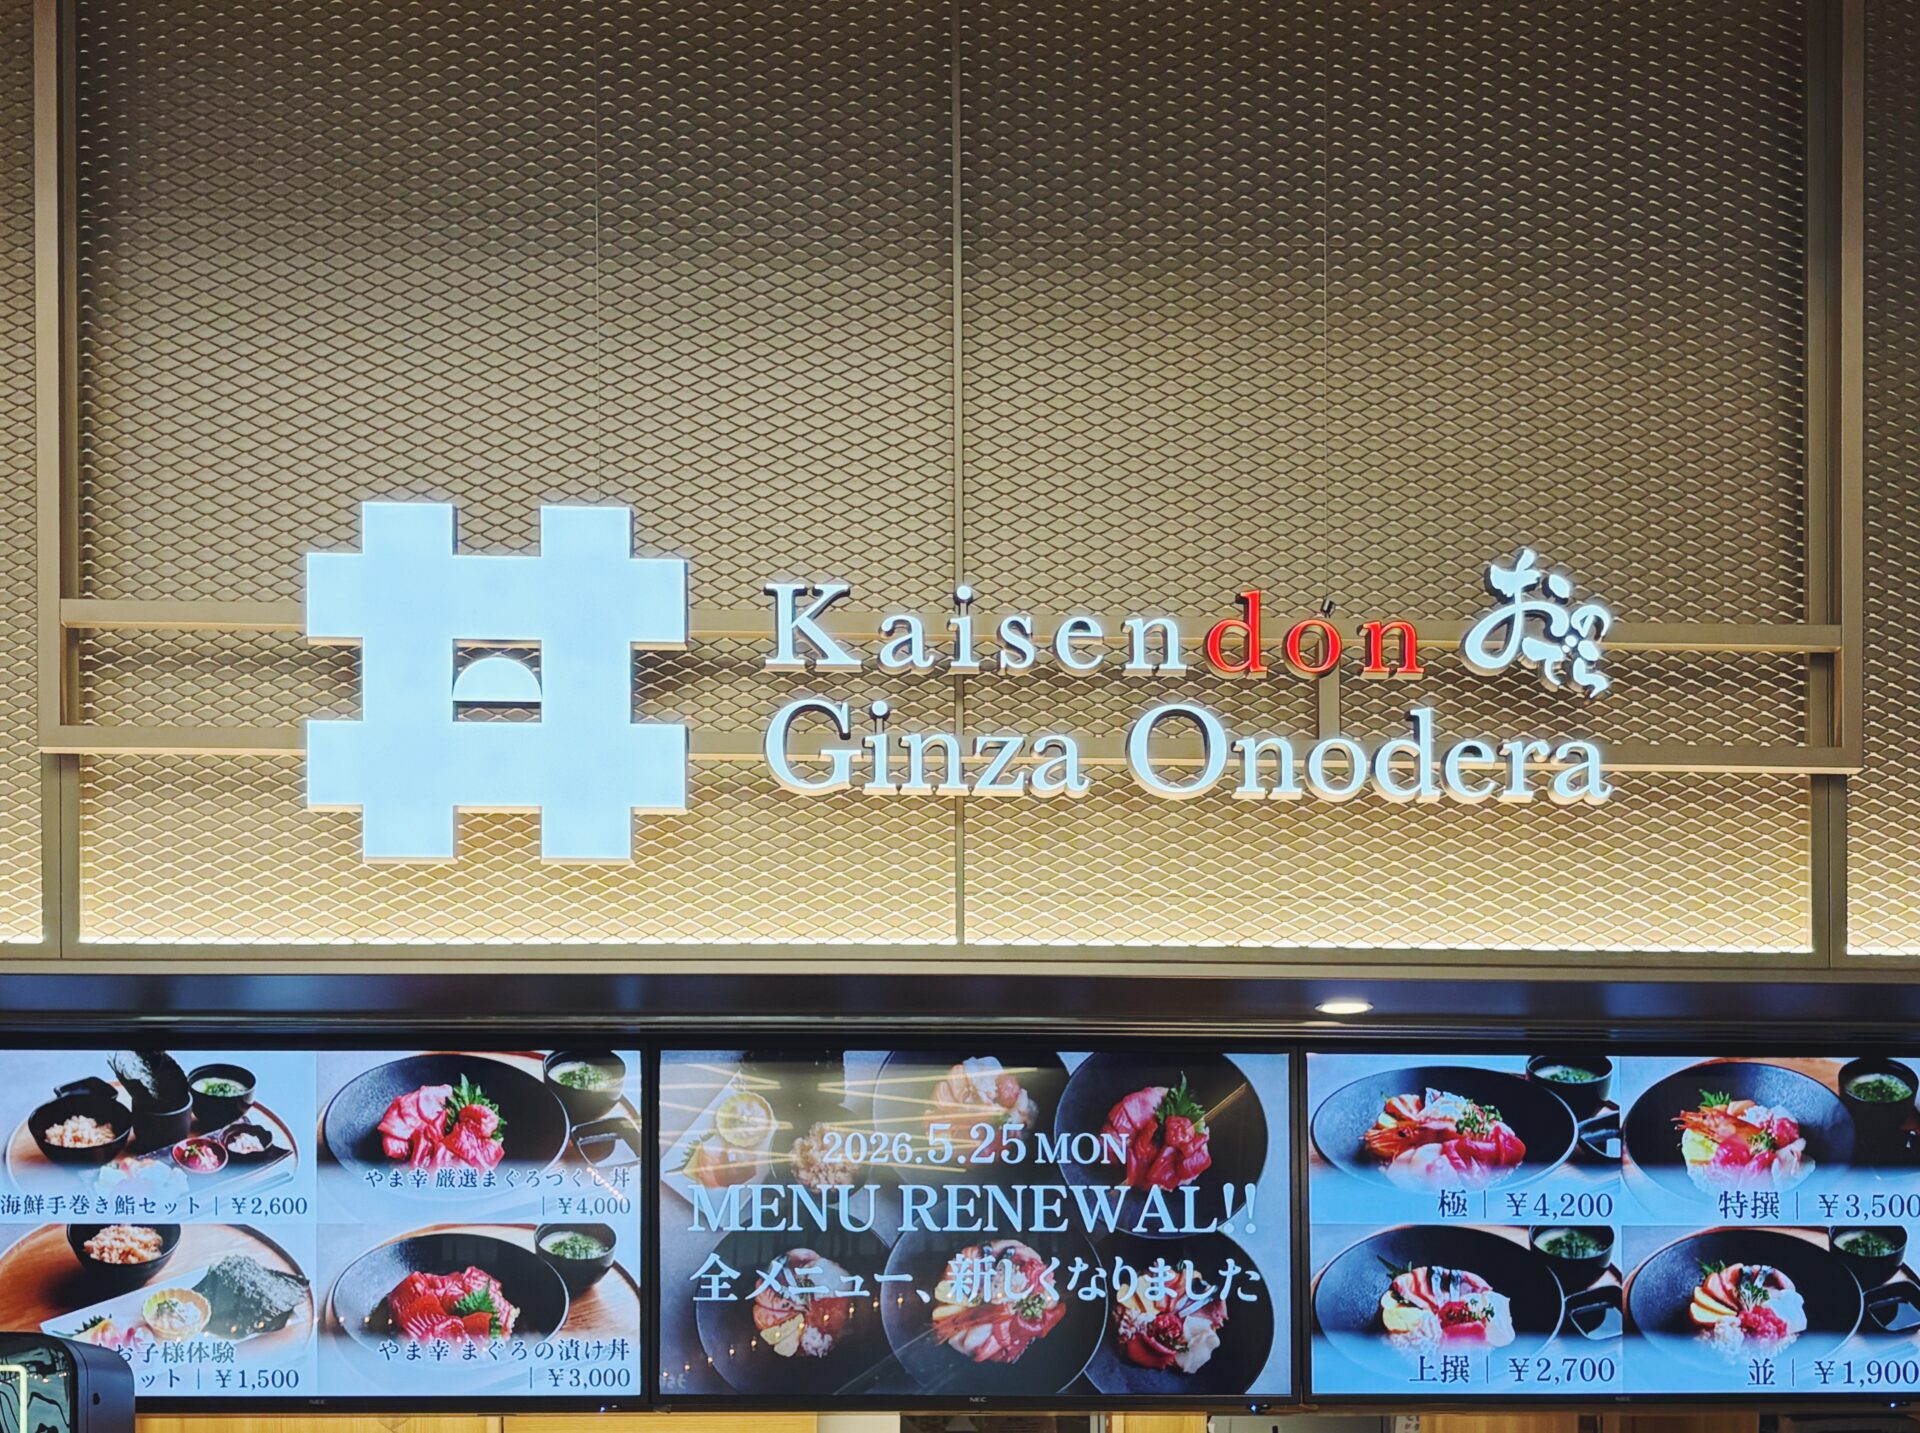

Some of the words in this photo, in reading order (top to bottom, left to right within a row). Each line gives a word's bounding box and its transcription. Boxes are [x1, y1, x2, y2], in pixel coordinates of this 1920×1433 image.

[764, 699, 1089, 796] Ginza
[1127, 703, 1613, 804] Onodera
[821, 1123, 1027, 1165] 2026.5.25
[1034, 1132, 1129, 1164] MON
[1, 1195, 201, 1215] 海鮮手巻き鮨セット
[232, 1197, 308, 1216] ¥2,600
[558, 1197, 632, 1216] ¥4,000
[687, 1184, 876, 1232] MENU
[897, 1183, 1257, 1234] RENEWAL!!
[1438, 1189, 1468, 1217] 極
[1506, 1193, 1613, 1219] ¥4,200
[1719, 1191, 1780, 1219] 特撰
[1818, 1194, 1920, 1221] ¥3,500
[690, 1252, 1260, 1303] 全メニュー、新しくなりました
[99, 1341, 235, 1363] お子様体験
[461, 1338, 630, 1361] まぐろの漬け丼
[215, 1369, 299, 1390] ¥1,500
[548, 1368, 631, 1389] ¥3,000
[1409, 1355, 1469, 1383] 上撰
[1509, 1357, 1615, 1385] ¥2,700
[1747, 1358, 1776, 1386] 並
[1814, 1360, 1919, 1387] ¥1,900
